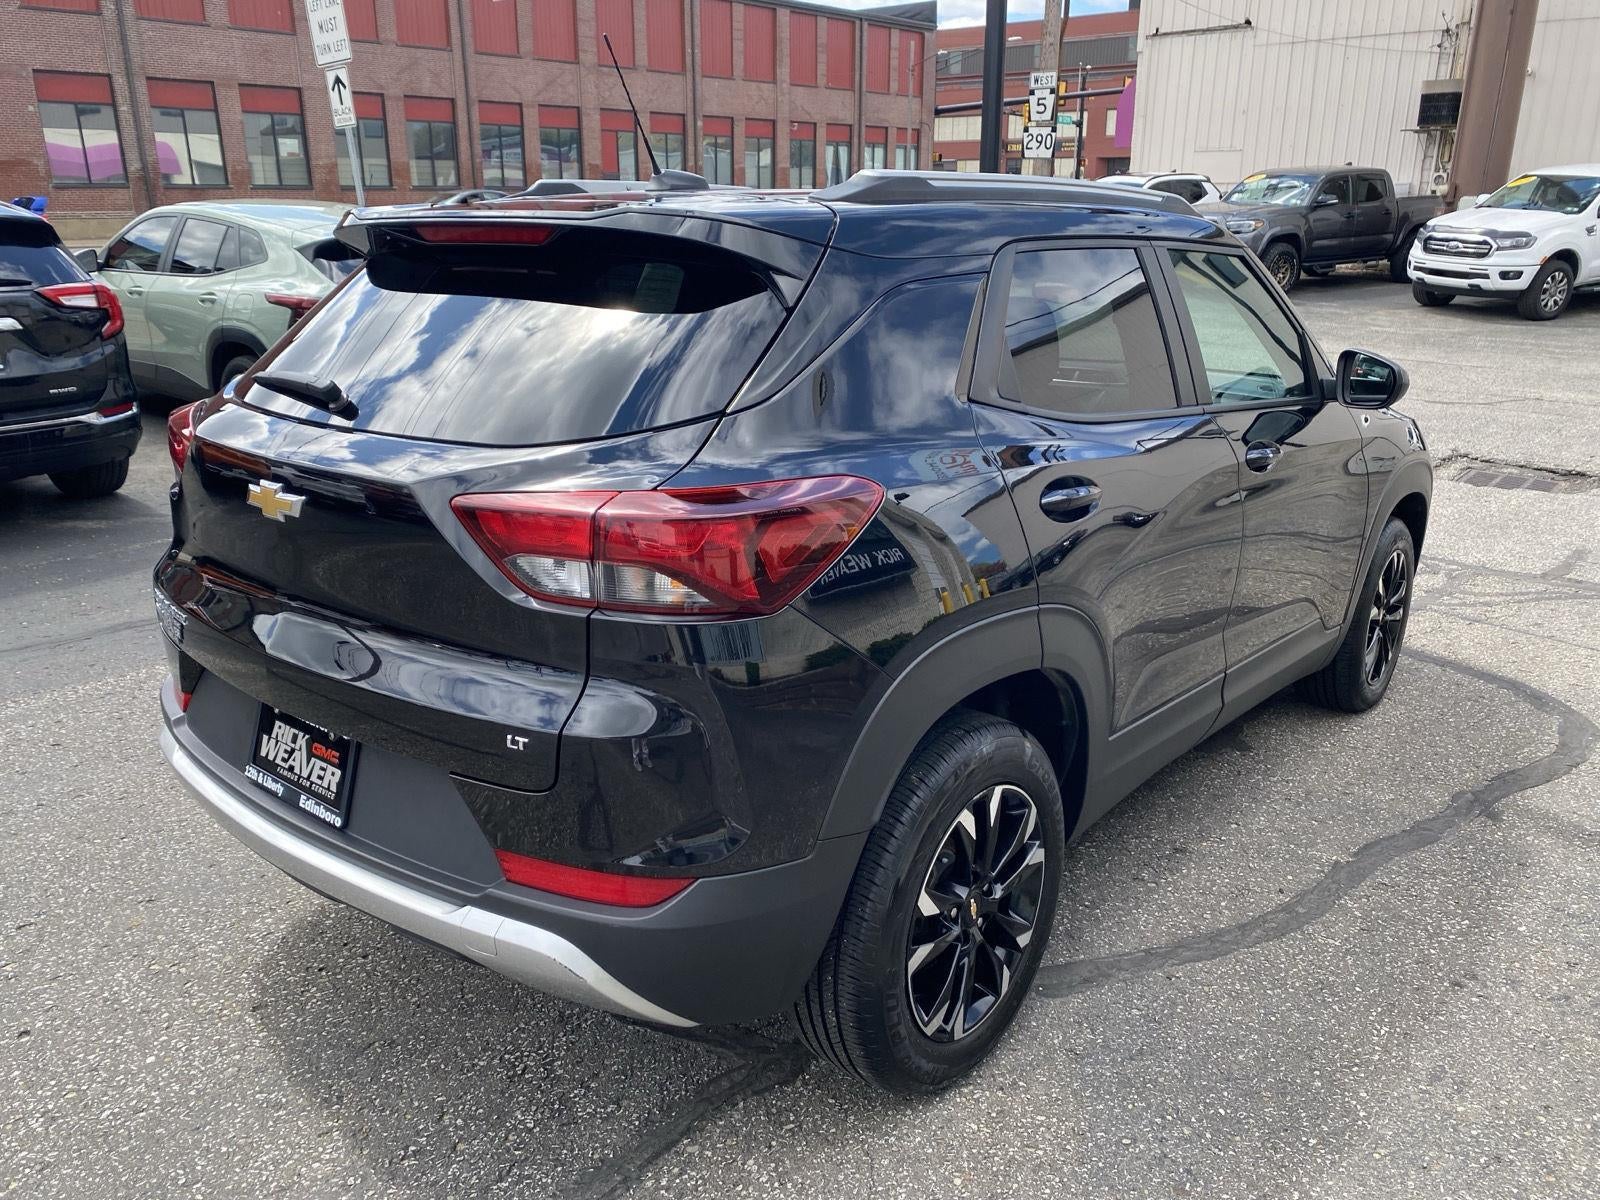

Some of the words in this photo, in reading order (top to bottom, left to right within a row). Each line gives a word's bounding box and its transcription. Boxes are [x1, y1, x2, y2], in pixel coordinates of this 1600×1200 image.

[317, 16, 337, 33] MUST
[316, 43, 332, 56] TURN
[333, 39, 347, 52] LEFT
[1033, 75, 1054, 86] WEST
[334, 106, 352, 117] BLACK
[1036, 97, 1047, 114] 5
[1025, 133, 1053, 150] 290
[272, 720, 311, 750] RICK
[506, 734, 529, 751] LT
[312, 742, 340, 765] GMC
[260, 735, 341, 792] WEAVER
[244, 765, 258, 781] 12th
[257, 773, 264, 784] &
[263, 775, 284, 797] Liberty
[276, 766, 298, 782] FAMOUS
[299, 778, 310, 788] FOR
[311, 783, 336, 800] SERVICE
[299, 795, 342, 827] Edinboro
